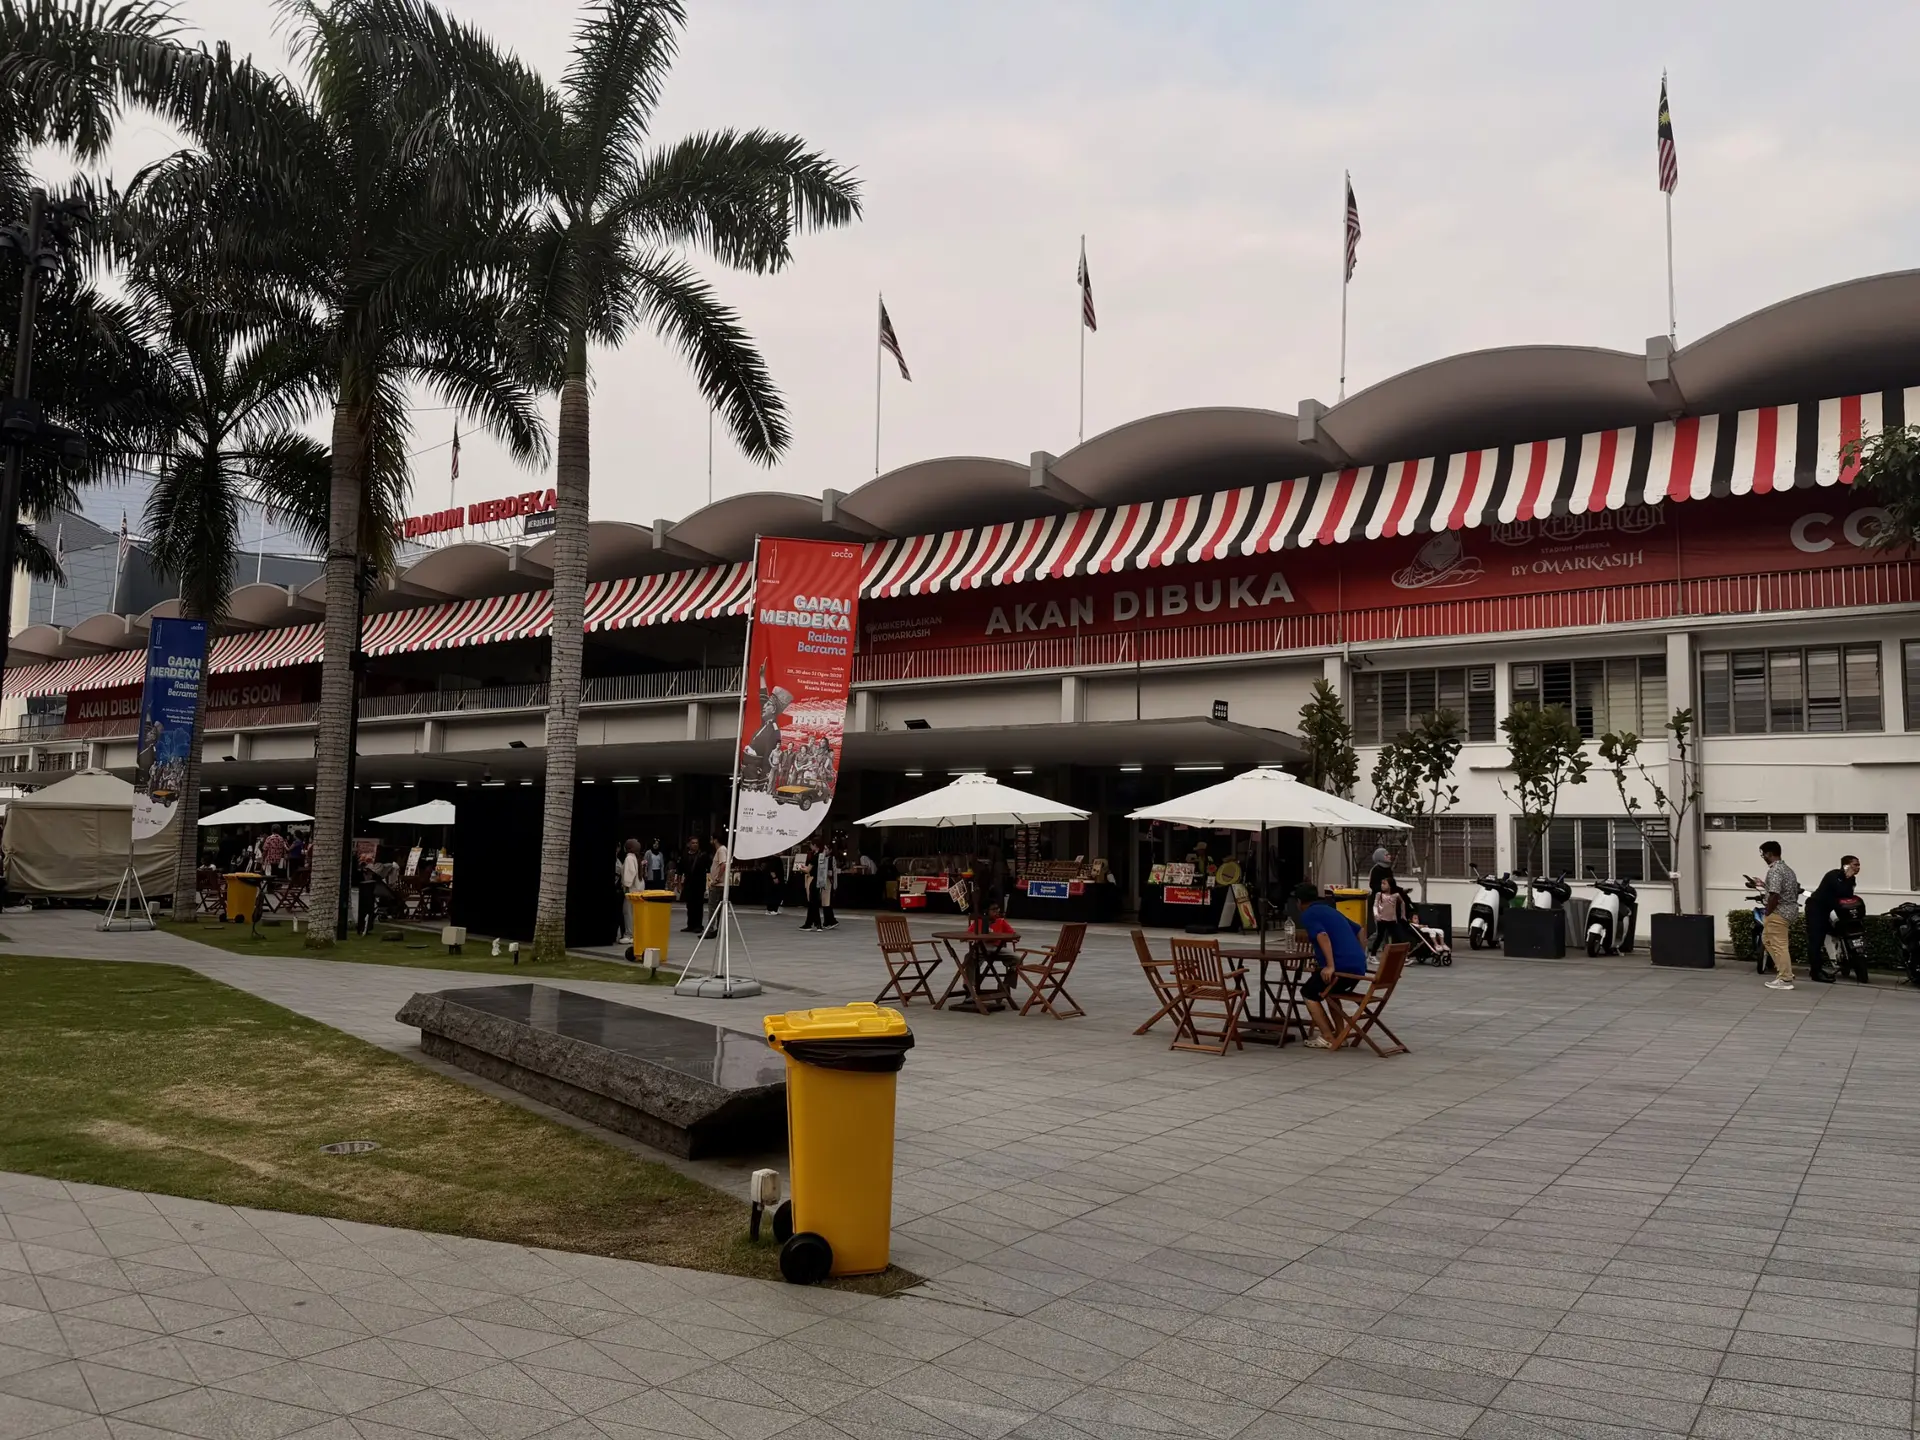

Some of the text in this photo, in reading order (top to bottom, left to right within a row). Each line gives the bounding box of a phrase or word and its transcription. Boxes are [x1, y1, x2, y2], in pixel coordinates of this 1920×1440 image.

[468, 489, 558, 525] MERDEKA
[1790, 506, 1897, 553] CO
[831, 551, 853, 559] LOCCO
[1512, 565, 1528, 576] BY
[793, 595, 852, 614] GAPAI
[984, 572, 1295, 635] AKAN DIBUKA
[759, 609, 851, 631] MERDEKA
[807, 631, 848, 645] Raikan
[797, 642, 847, 656] Bersama
[150, 666, 201, 680] MERDEKA
[206, 683, 281, 708] MING SOON
[78, 697, 143, 718] AKAN DIBU
